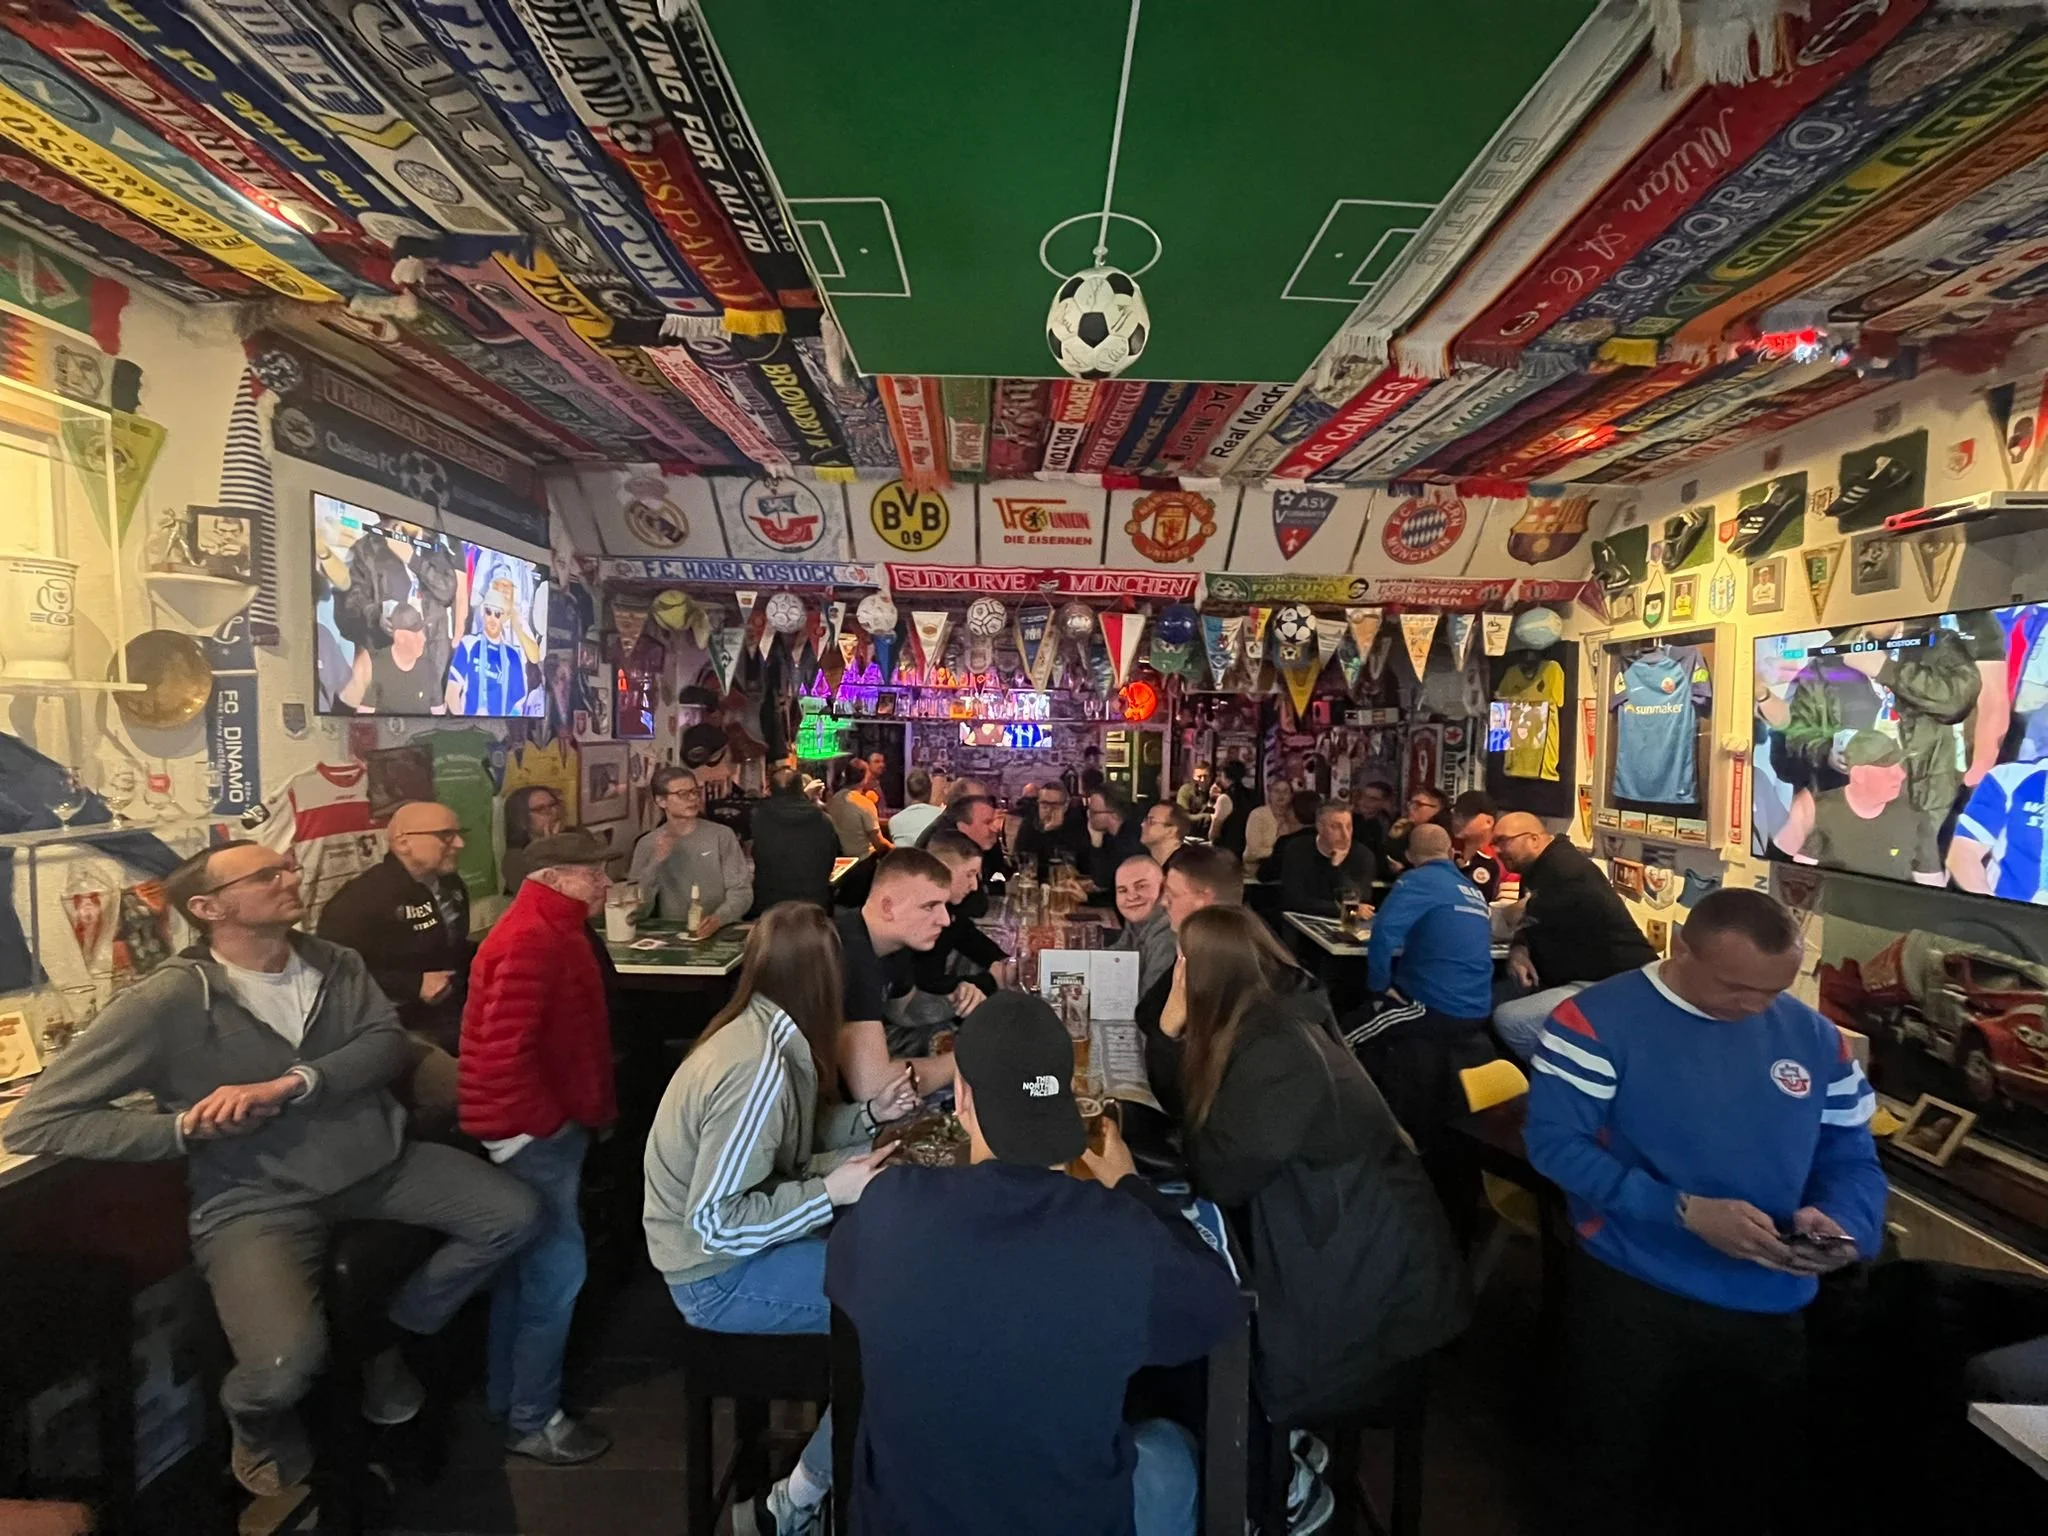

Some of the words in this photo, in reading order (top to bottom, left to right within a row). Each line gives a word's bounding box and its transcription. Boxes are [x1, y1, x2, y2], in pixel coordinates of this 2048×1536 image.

[153, 43, 217, 83] of
[242, 33, 362, 106] AFC
[222, 91, 327, 165] pride
[350, 3, 597, 266] Ultras
[565, 128, 594, 159] OF
[109, 125, 299, 246] FORZA
[316, 168, 372, 209] the
[672, 110, 722, 173] FOR
[711, 179, 763, 254] ALLTID
[1622, 107, 1735, 214] Milan
[1651, 120, 1848, 258] PORTO
[1725, 185, 1878, 272] SOUTH
[1880, 48, 2048, 168] AFRIC
[535, 137, 684, 292] NIPPON
[1413, 137, 1538, 267] CELTIC
[760, 364, 827, 438] BRØNDBY
[1211, 429, 1246, 460] Real
[1244, 384, 1297, 425] Madri
[1304, 443, 1338, 464] AS
[1333, 381, 1418, 441] CANNES
[1049, 427, 1078, 473] BOLTON
[880, 485, 942, 532] BVB
[1297, 497, 1328, 509] ASV
[900, 529, 922, 546] 09
[1003, 535, 1025, 545] DIE
[1028, 536, 1093, 546] EISERNEN
[685, 561, 749, 581] HANSA
[753, 562, 836, 583] ROSTOCK
[223, 689, 239, 714] FC
[1635, 701, 1685, 716] sunmaker
[223, 726, 244, 804] DINAMO
[1022, 1082, 1050, 1091] NORTH
[1030, 1089, 1050, 1098] FACE
[1036, 1075, 1049, 1084] THE
